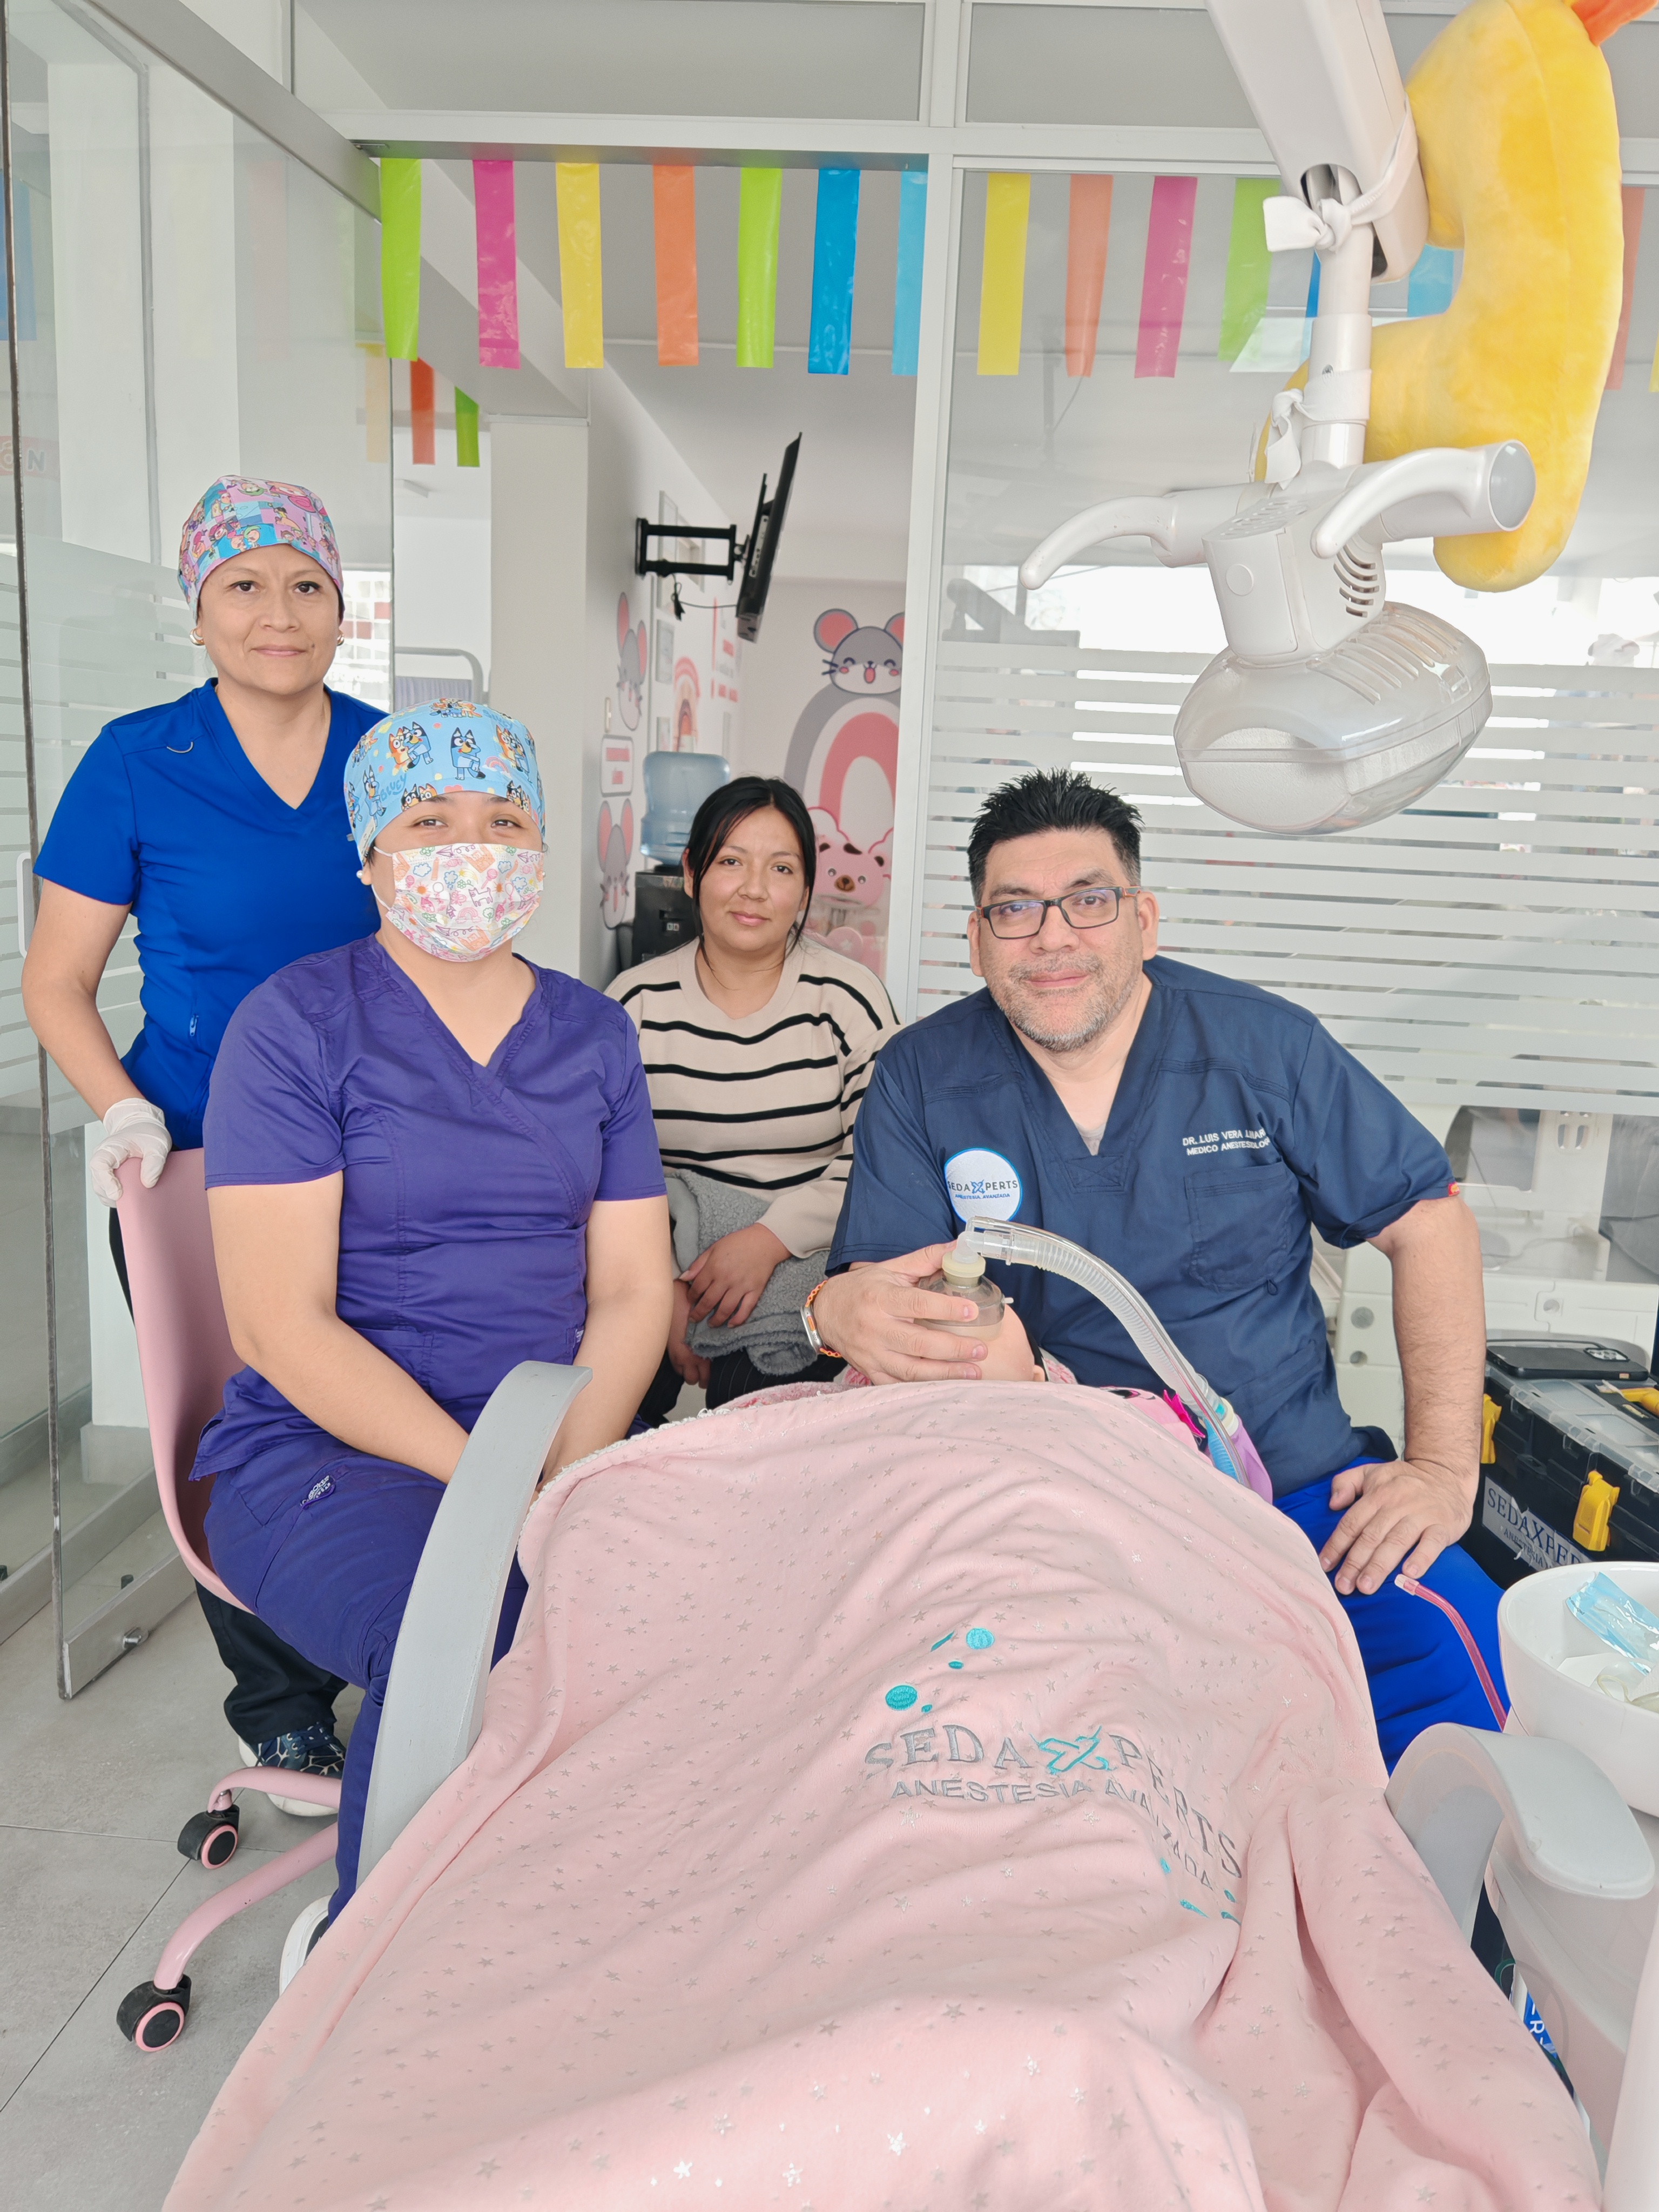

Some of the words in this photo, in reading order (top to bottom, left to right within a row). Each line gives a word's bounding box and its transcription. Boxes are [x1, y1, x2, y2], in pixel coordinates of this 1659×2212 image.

[380, 773, 407, 801] BLUEY
[1183, 1137, 1198, 1146] DR.
[1199, 1133, 1219, 1144] LUIS
[1221, 1130, 1243, 1139] VERA
[1186, 1145, 1218, 1156] MEDICO
[891, 1779, 1094, 1804] ANESTESIA
